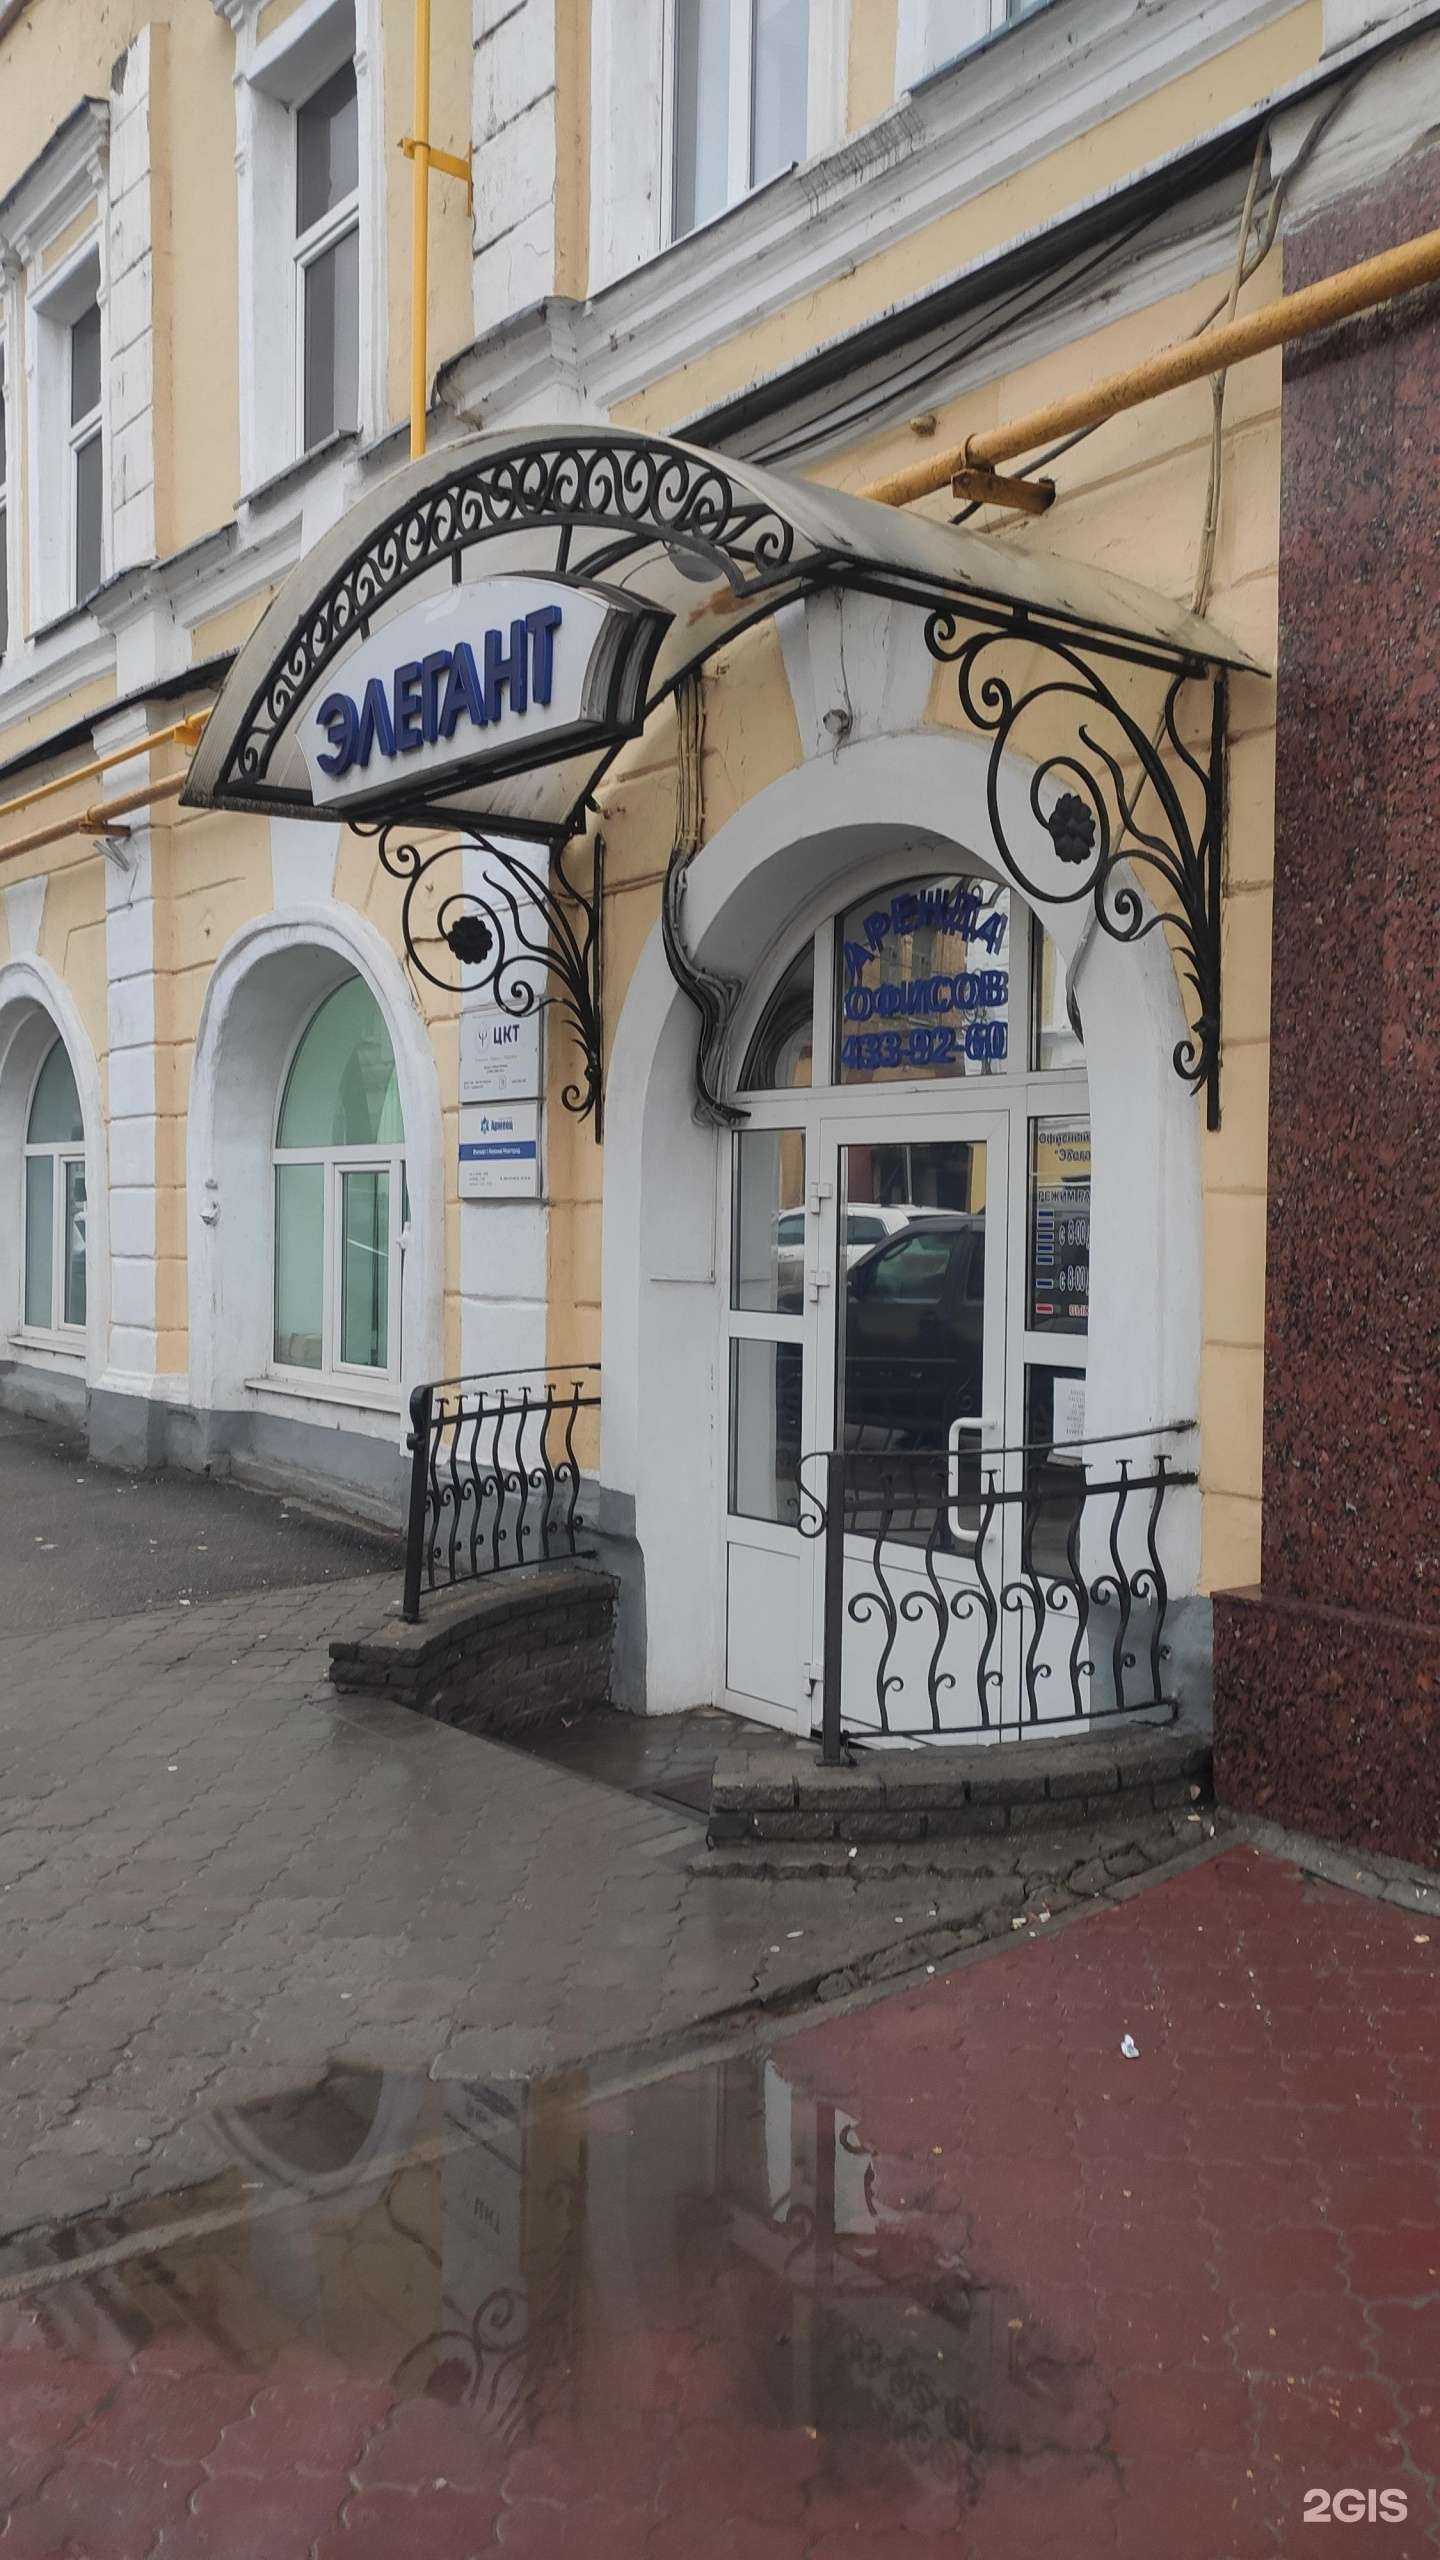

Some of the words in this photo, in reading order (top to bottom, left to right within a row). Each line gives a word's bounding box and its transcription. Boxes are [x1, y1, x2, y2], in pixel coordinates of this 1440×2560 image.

[317, 605, 562, 776] ЭЛЕГАНТ
[844, 887, 1009, 978] АРЕНДА
[844, 969, 1009, 1021] ОФИСОВ
[493, 1024, 520, 1046] ЦКТ
